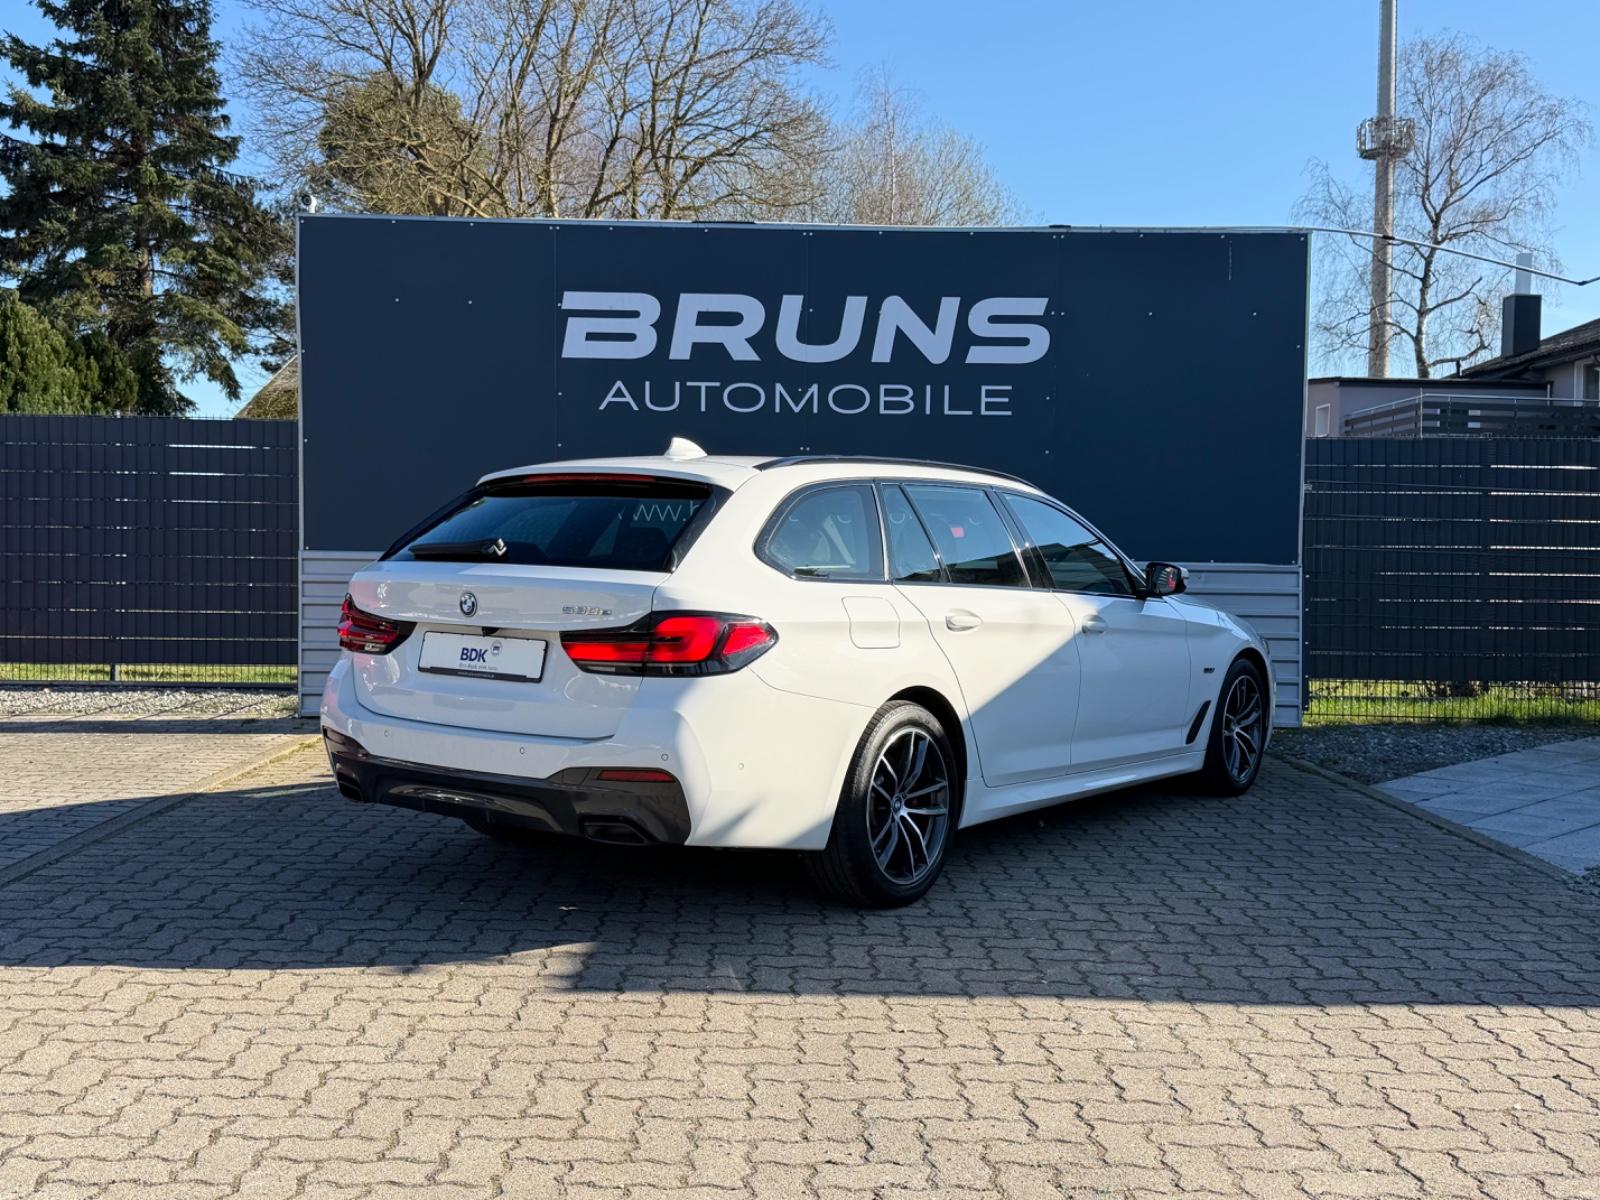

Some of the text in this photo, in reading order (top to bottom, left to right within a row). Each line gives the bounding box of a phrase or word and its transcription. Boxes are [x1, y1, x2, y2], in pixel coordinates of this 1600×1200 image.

[560, 290, 1051, 365] BRUNS
[598, 380, 1013, 416] AUTOMOBILE
[460, 647, 488, 663] BDK
